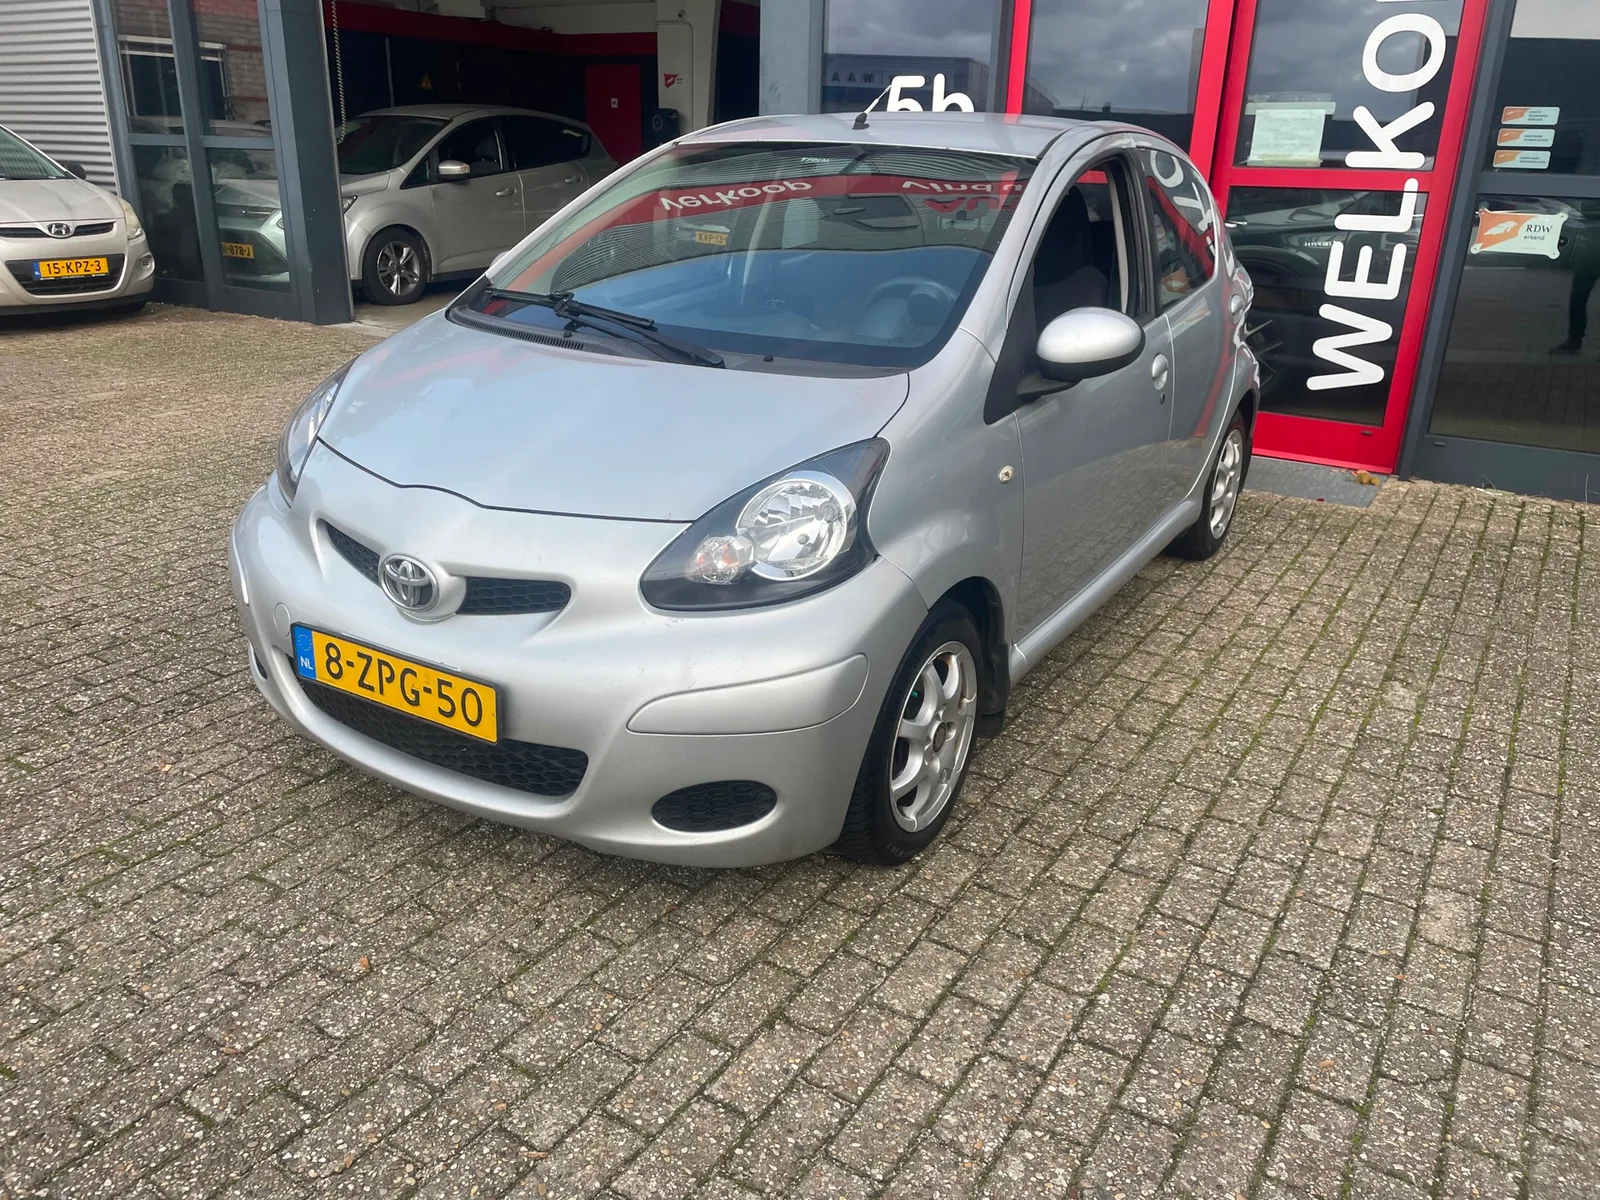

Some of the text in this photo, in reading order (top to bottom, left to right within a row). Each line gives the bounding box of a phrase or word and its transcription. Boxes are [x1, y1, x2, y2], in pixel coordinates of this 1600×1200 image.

[1306, 0, 1447, 391] WELKO
[1526, 224, 1553, 233] RDW
[698, 232, 728, 245] KVP-13-
[46, 260, 102, 275] 15-KPZ-3
[300, 656, 313, 670] NL
[325, 642, 483, 728] 8-ZPG-50
